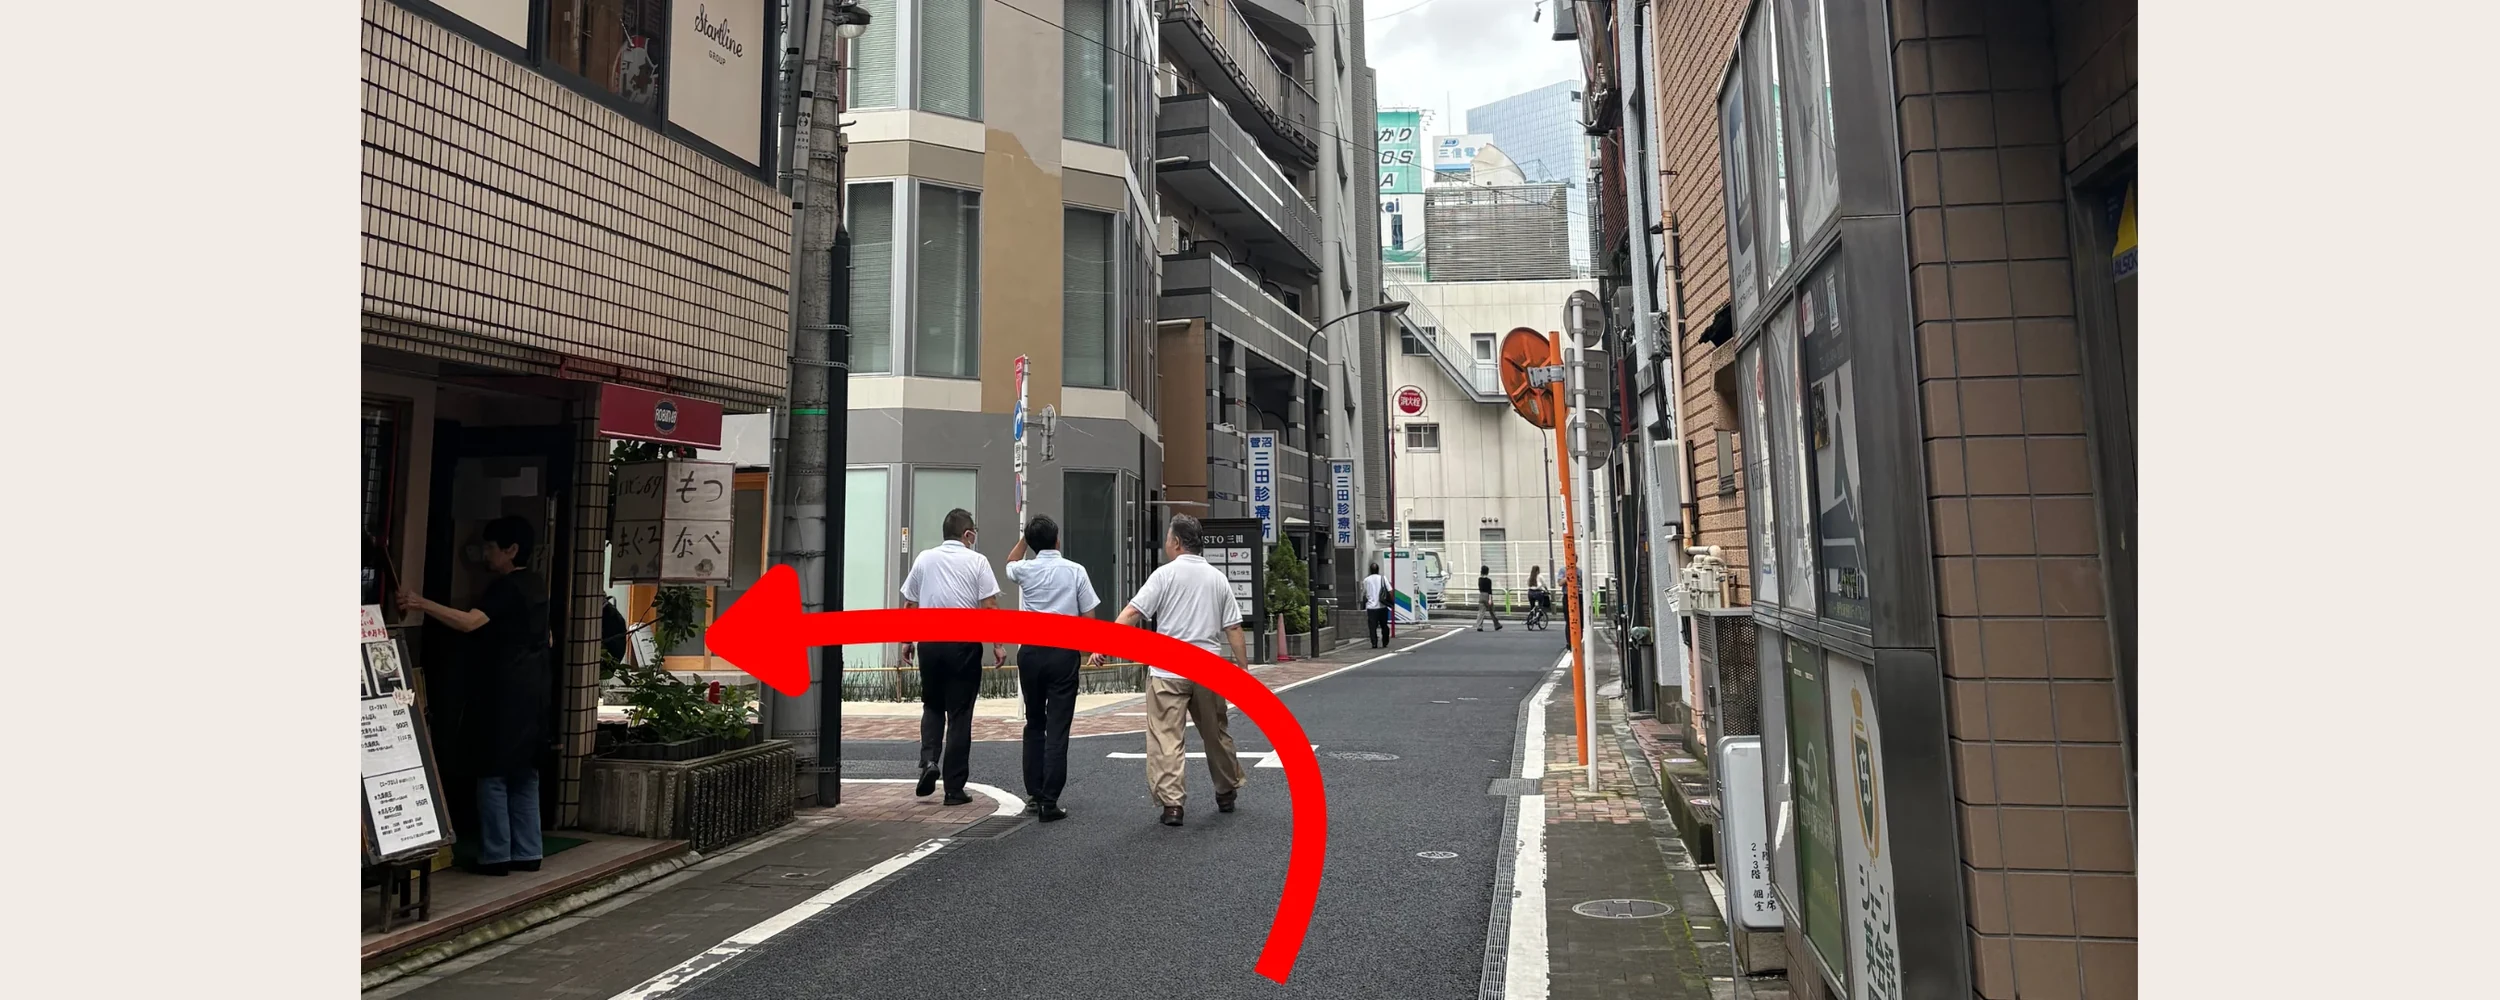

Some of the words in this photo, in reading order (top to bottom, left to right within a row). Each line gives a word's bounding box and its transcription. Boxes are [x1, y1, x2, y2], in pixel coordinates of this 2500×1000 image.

[694, 3, 743, 58] Startline
[708, 49, 726, 66] GROUP
[1250, 437, 1272, 448] 菅沼
[1333, 464, 1351, 474] 菅沼
[676, 471, 723, 503] もつ
[1336, 476, 1351, 543] 三田診療所
[617, 525, 661, 560] まぐろ
[672, 526, 721, 558] なべ
[1201, 535, 1224, 544] STO
[1753, 889, 1764, 912] 個室
[1858, 862, 1891, 935] シェーン
